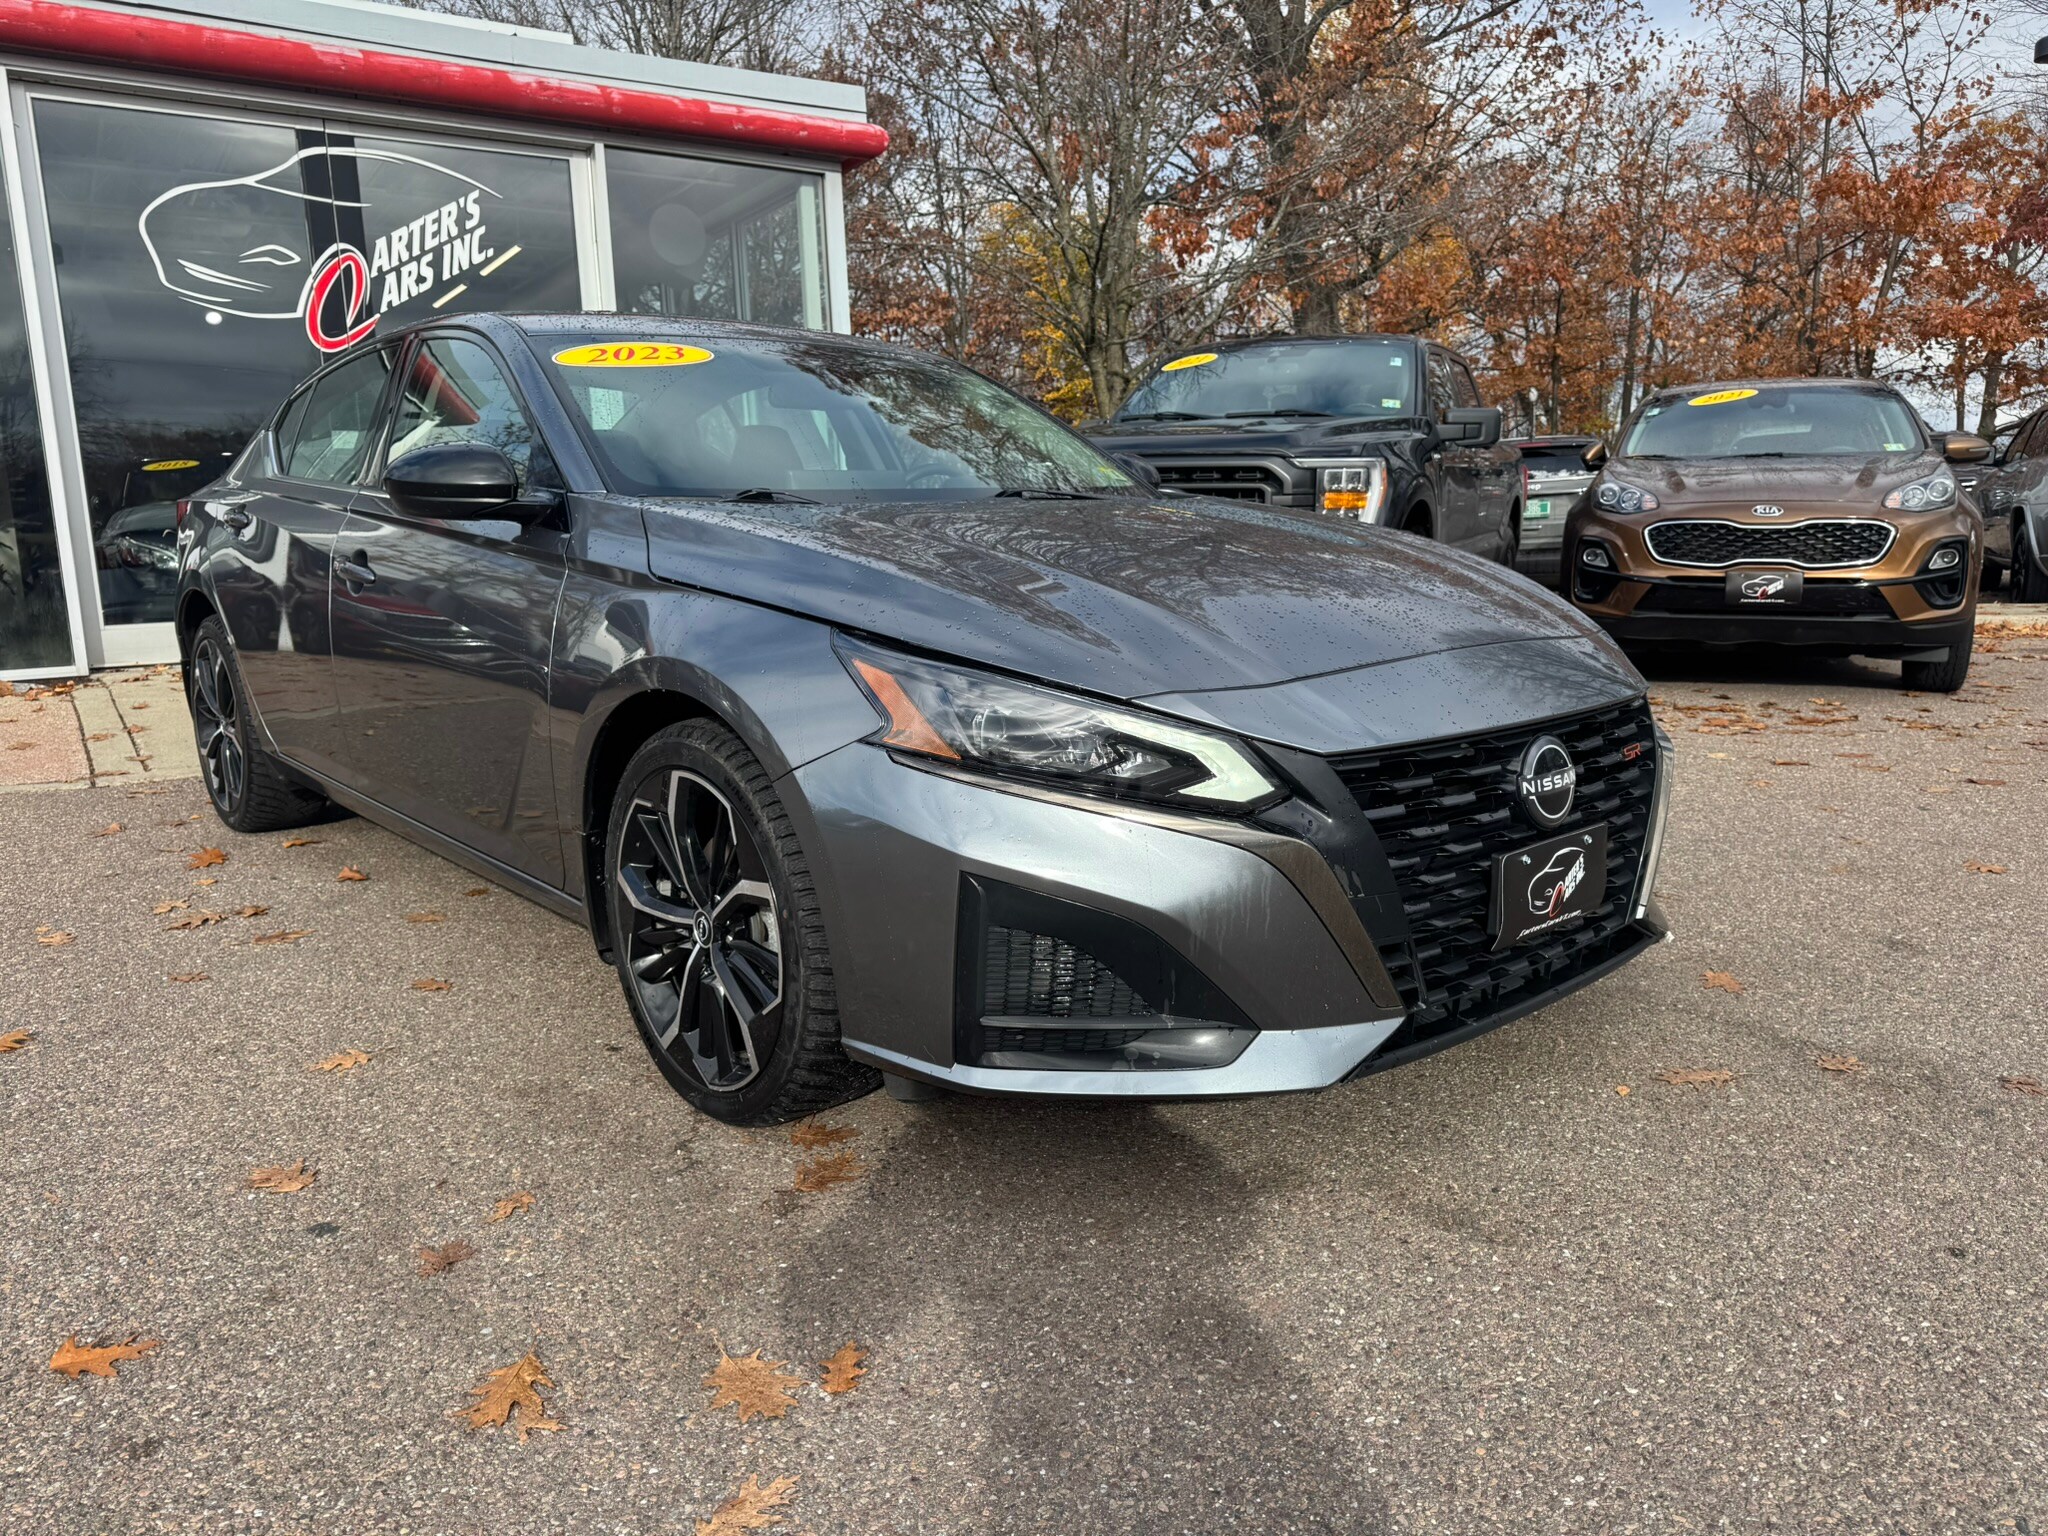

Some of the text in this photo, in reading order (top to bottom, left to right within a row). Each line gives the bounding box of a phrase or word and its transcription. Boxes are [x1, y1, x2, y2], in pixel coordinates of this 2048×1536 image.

[442, 225, 494, 281] INC.
[587, 346, 685, 363] 2023
[1623, 743, 1641, 761] SR
[1522, 767, 1576, 795] NISSAN
